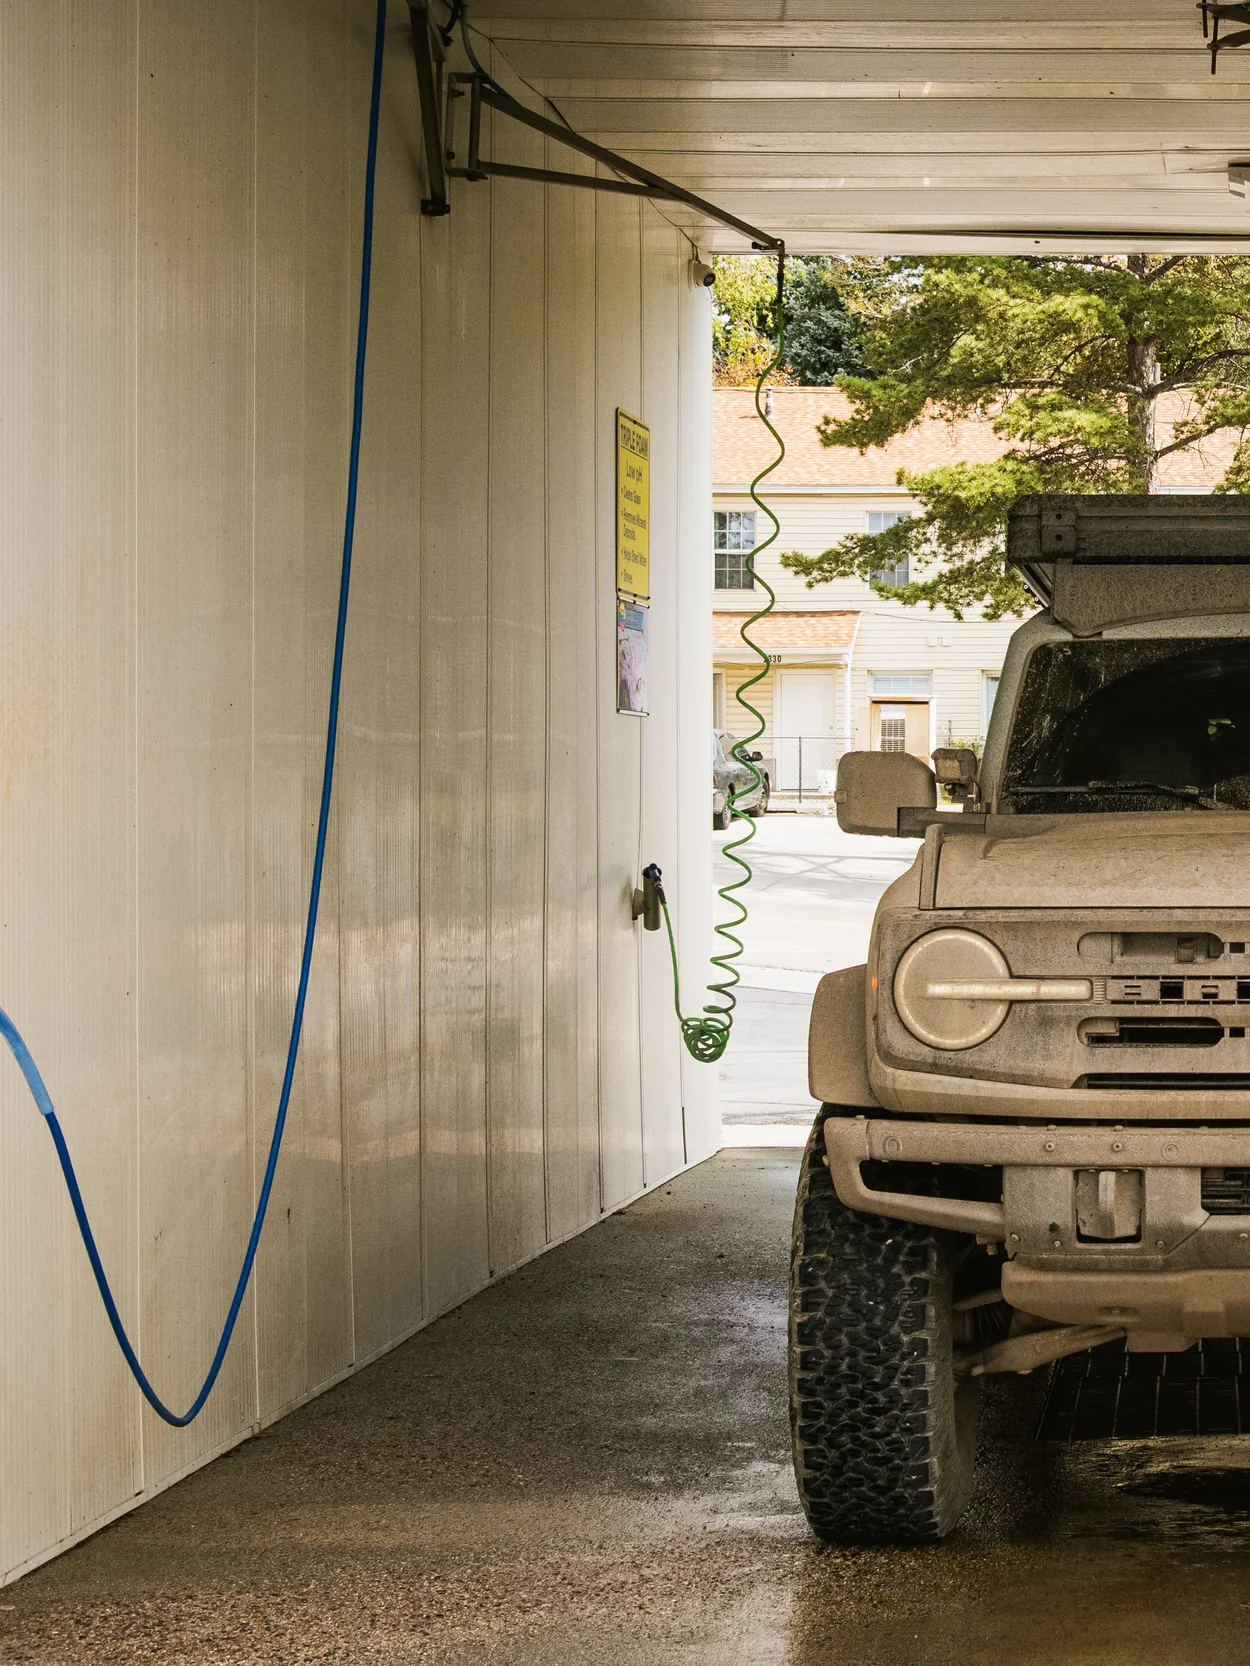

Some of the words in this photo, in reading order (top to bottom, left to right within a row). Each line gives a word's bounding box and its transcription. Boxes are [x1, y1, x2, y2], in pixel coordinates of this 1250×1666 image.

[620, 423, 635, 449] TRIPLE
[626, 460, 635, 480] Low
[763, 654, 782, 663] 330
